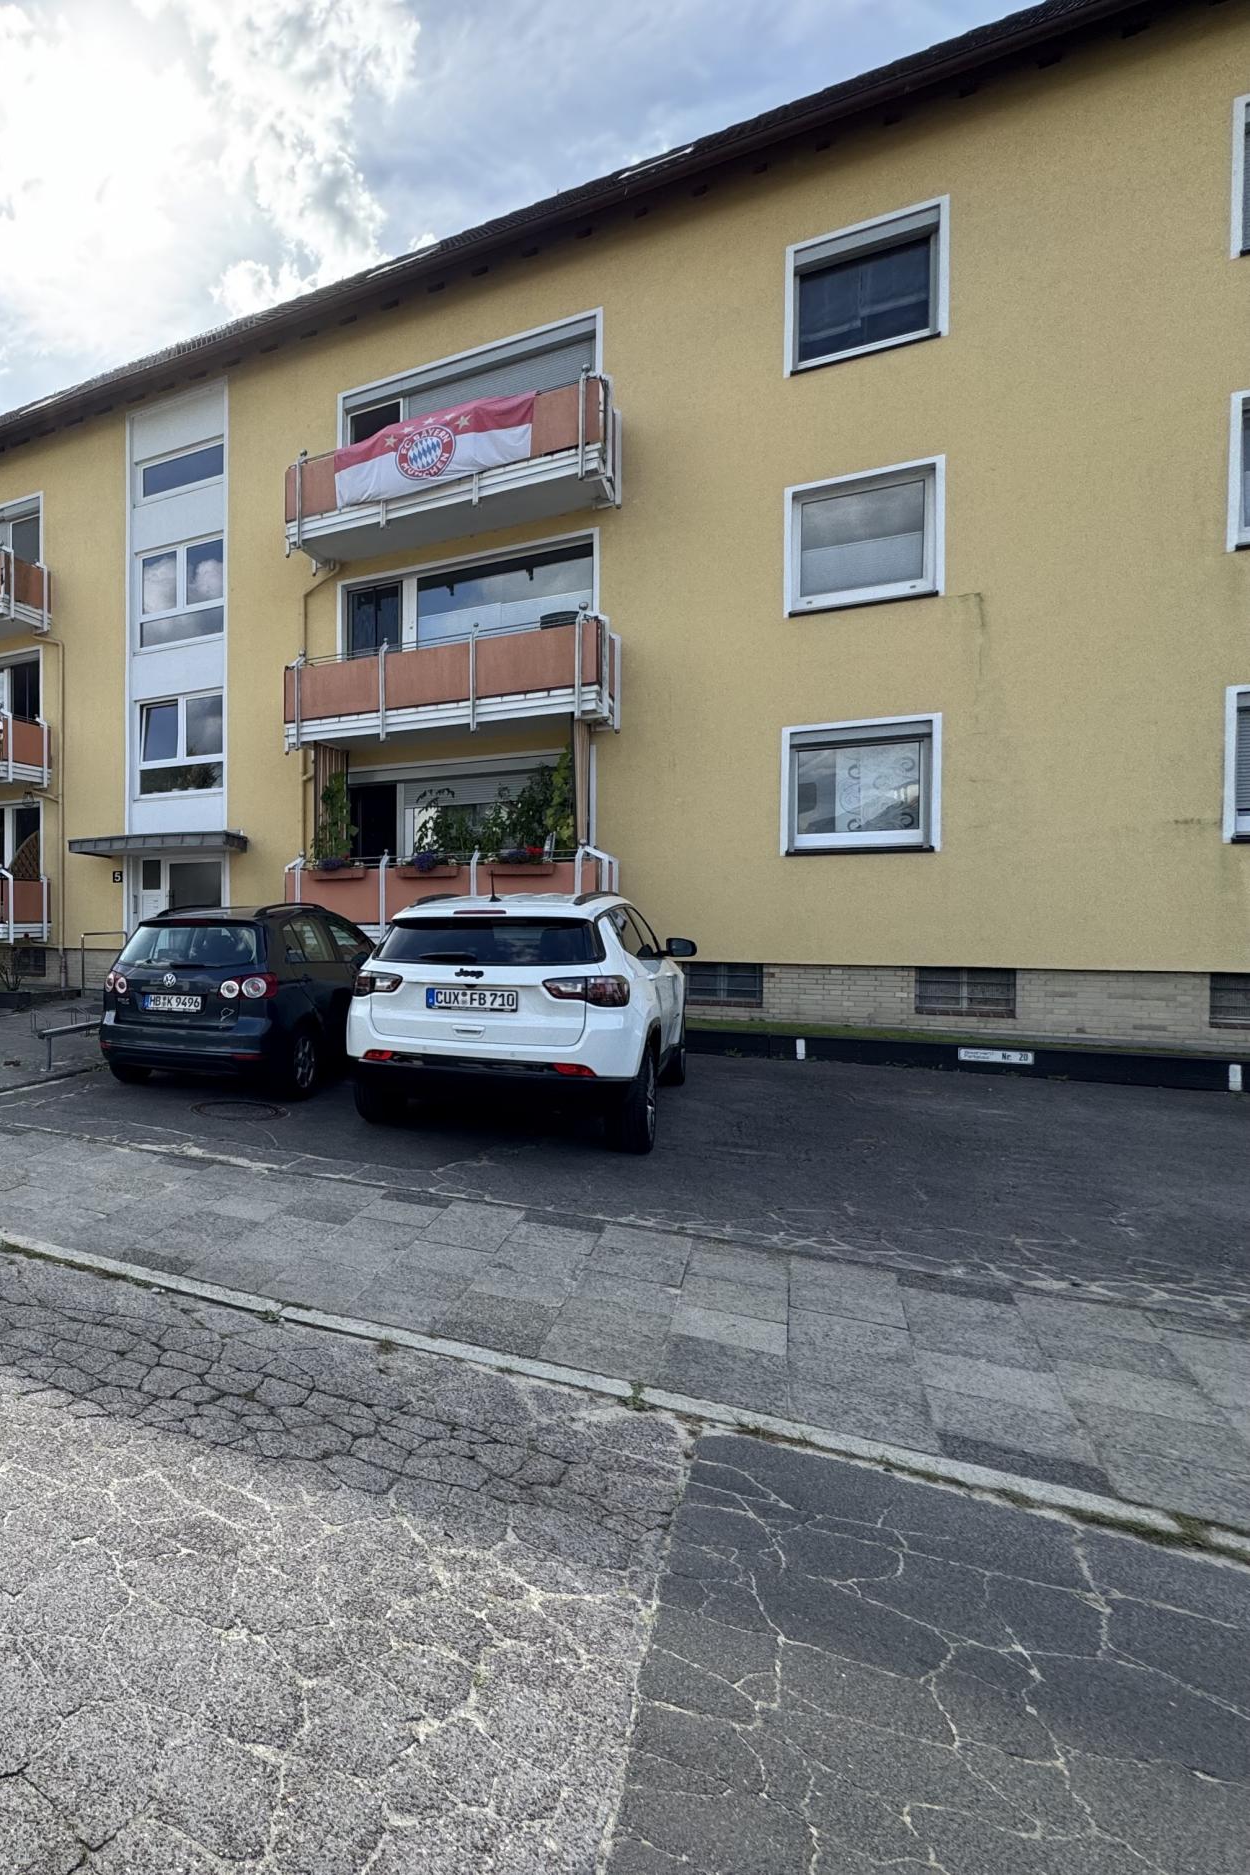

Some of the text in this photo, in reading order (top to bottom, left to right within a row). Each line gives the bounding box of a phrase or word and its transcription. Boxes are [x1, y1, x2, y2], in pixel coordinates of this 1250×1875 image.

[401, 428, 451, 454] FC BAYERN
[114, 871, 121, 882] 5
[454, 968, 484, 979] Jeep
[149, 995, 200, 1008] HB K 9496
[435, 990, 515, 1007] CUX FB 710
[1019, 1053, 1029, 1061] 20
